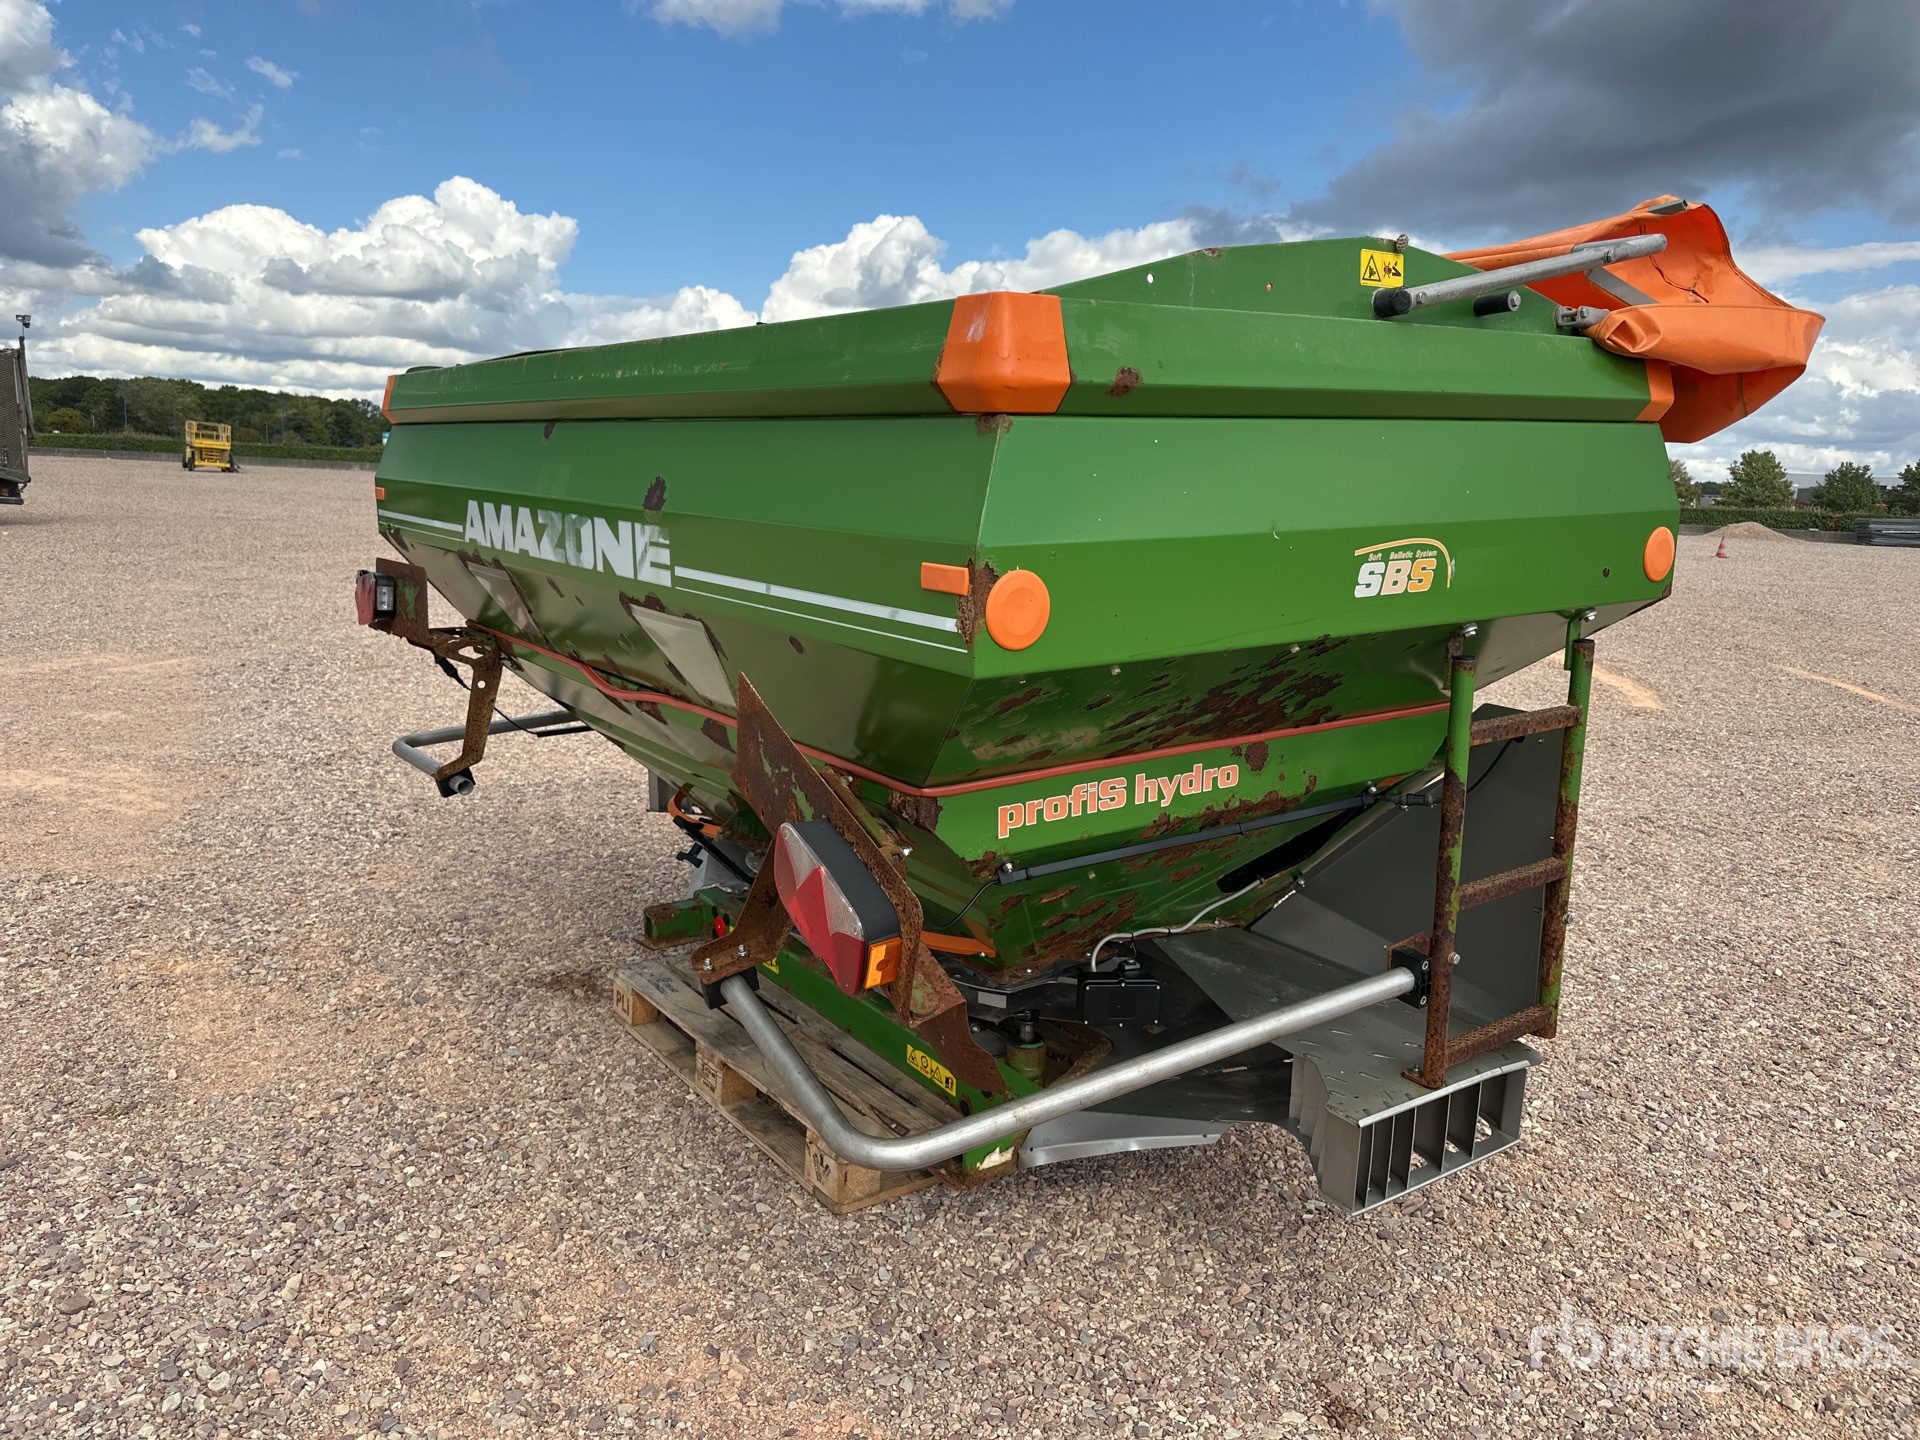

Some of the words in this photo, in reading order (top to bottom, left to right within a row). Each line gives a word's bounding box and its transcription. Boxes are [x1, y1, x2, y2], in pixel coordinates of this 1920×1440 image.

[464, 500, 672, 587] AMAZONE
[1368, 553, 1382, 561] Soft
[1389, 551, 1413, 560] Ballistic
[1415, 549, 1437, 558] System
[1354, 559, 1437, 598] SBS
[998, 777, 1127, 839] profiS
[1134, 763, 1239, 807] hydro
